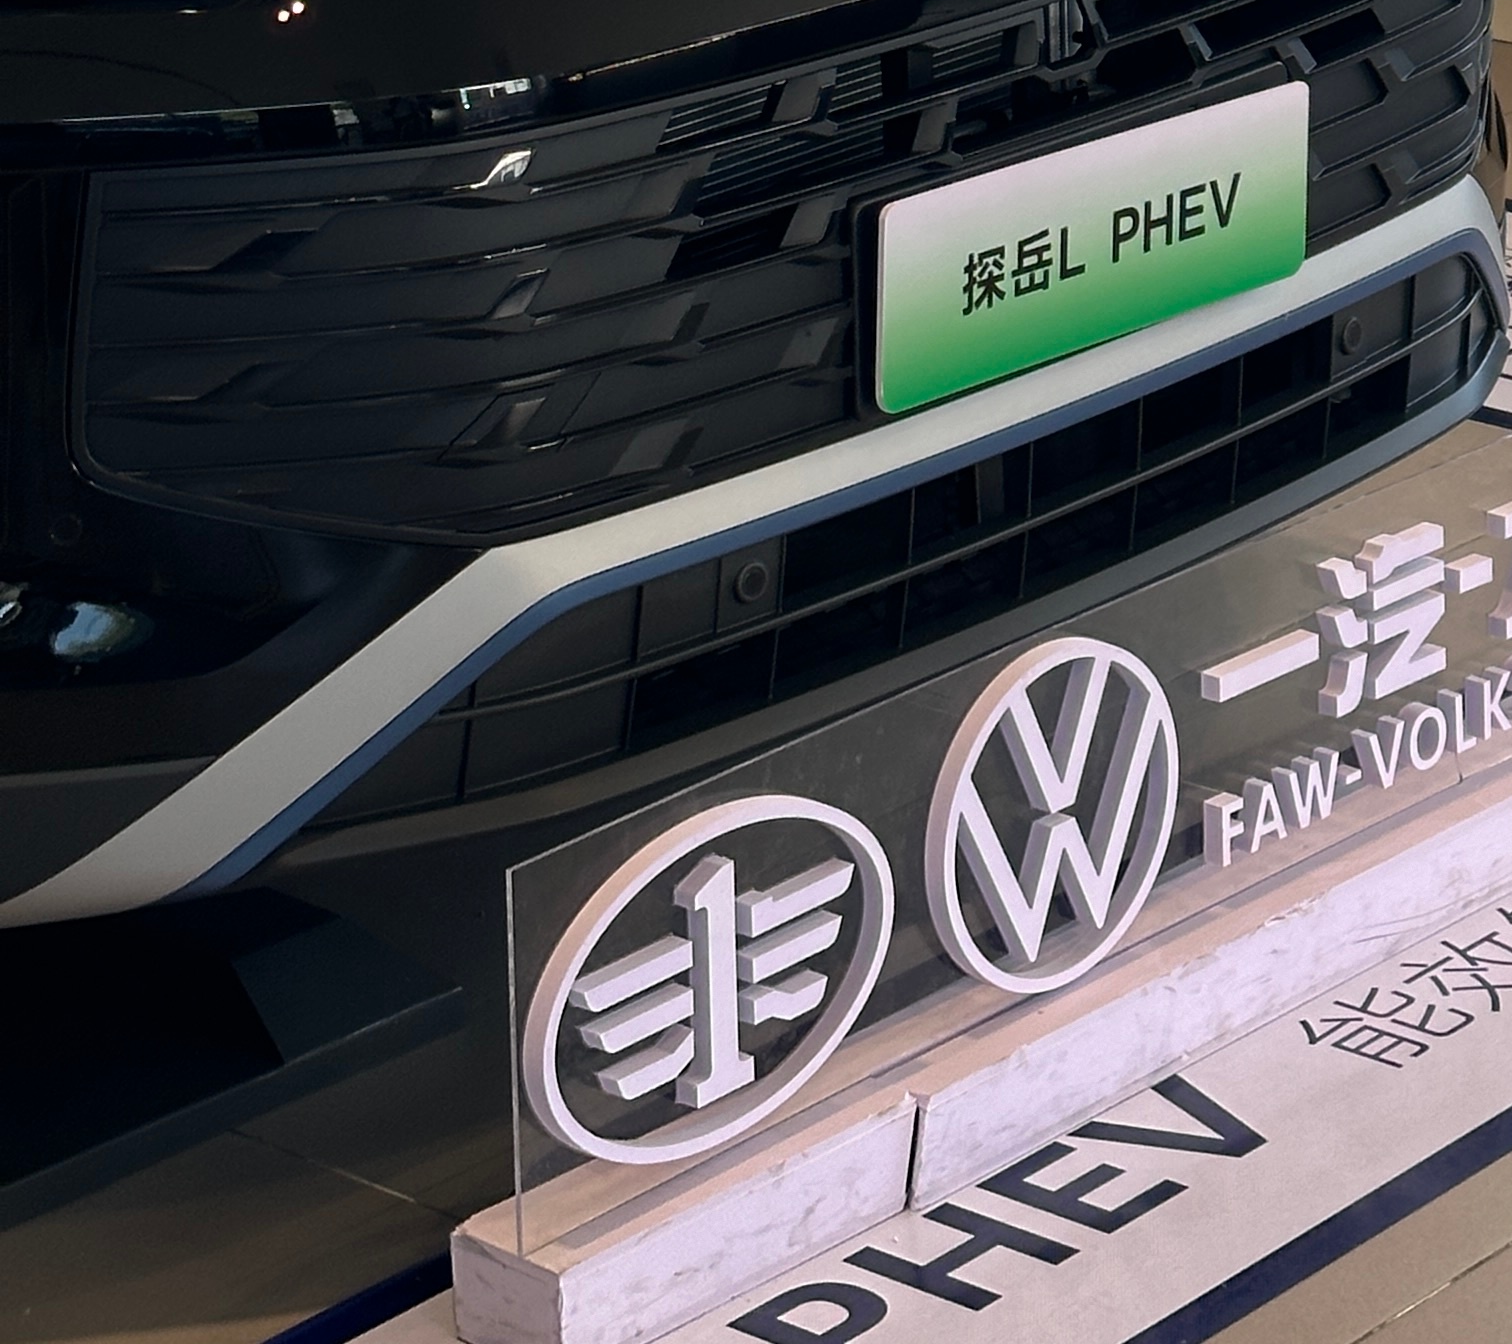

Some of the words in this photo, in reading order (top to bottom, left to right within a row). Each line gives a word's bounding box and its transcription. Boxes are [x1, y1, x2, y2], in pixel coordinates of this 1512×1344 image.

[962, 226, 1086, 317] 探岳L
[1111, 172, 1242, 263] PHEV
[727, 1074, 1269, 1344] PHEV
